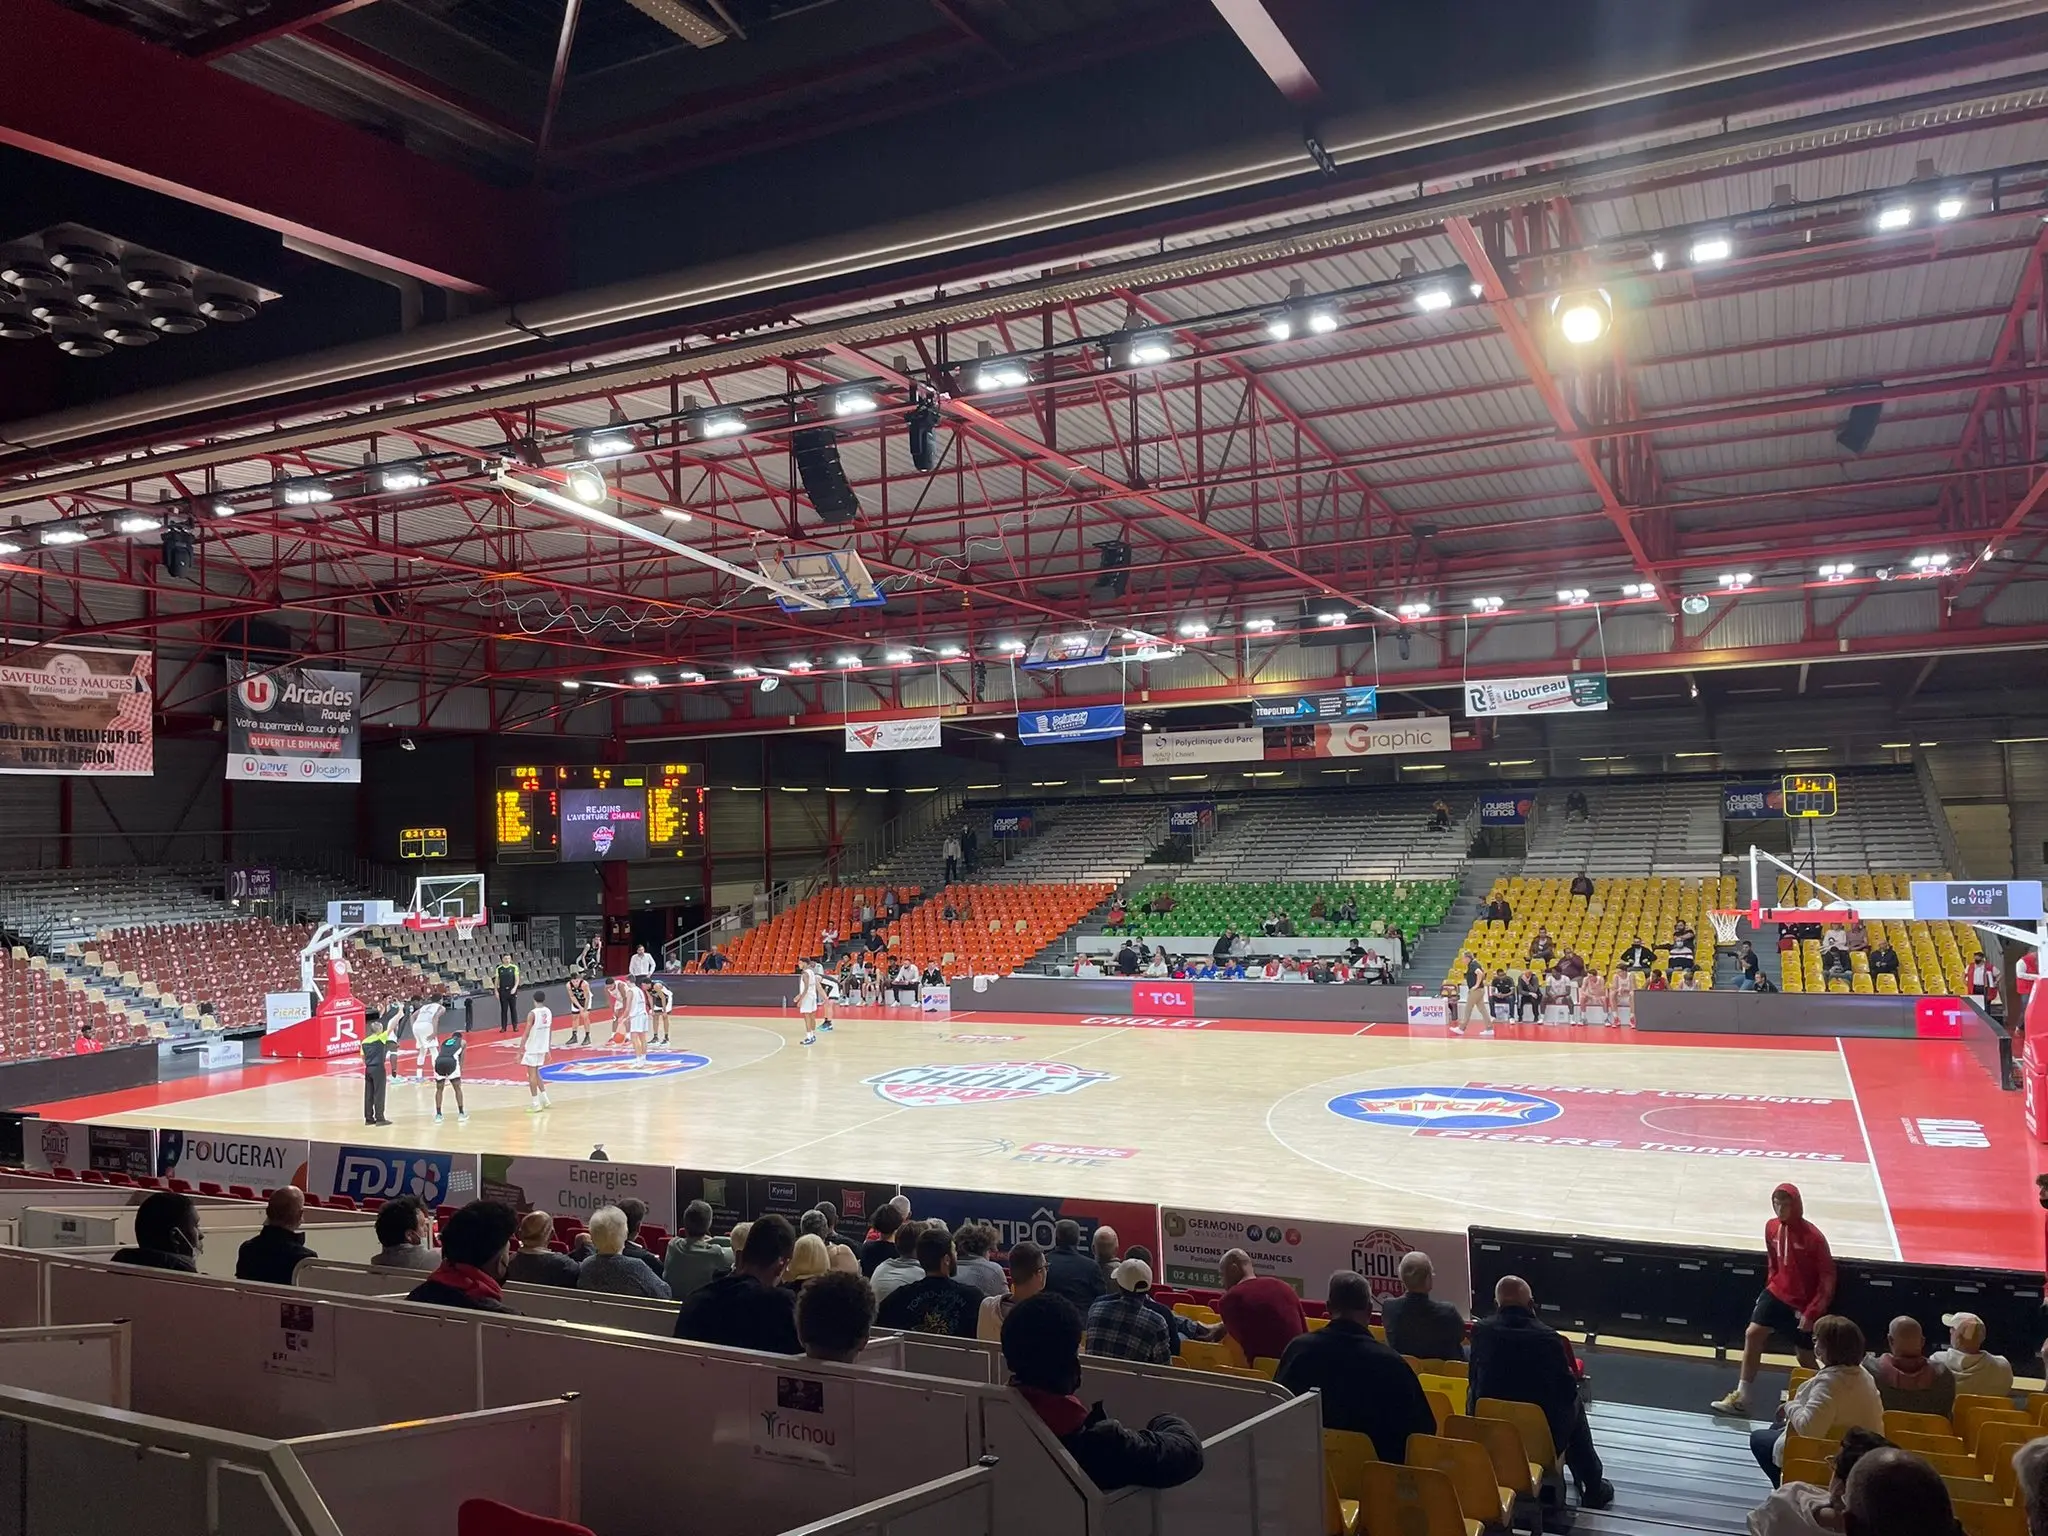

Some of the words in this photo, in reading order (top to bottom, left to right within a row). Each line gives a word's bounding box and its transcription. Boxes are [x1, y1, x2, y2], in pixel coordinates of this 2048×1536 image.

[1, 669, 57, 686] SAVEURS
[59, 676, 78, 686] DES
[80, 677, 133, 691] MAUGES
[281, 683, 353, 706] Arcades
[1503, 680, 1567, 702] Liboureau
[321, 708, 352, 723] Rougé
[236, 717, 258, 729] Votre
[259, 719, 305, 733] supermarché
[48, 726, 61, 742] LE
[64, 728, 124, 744] MEILLEUR
[127, 730, 143, 745] DE
[1175, 736, 1222, 748] Polyclinique
[1224, 735, 1235, 745] du
[1236, 734, 1254, 744] Parc
[1344, 723, 1433, 753] Graphic
[251, 736, 286, 747] OUVERT
[287, 738, 297, 748] LE
[298, 739, 341, 750] DIMANCHE
[21, 746, 66, 763] VOTRE
[260, 763, 288, 772] DRIVE
[316, 766, 350, 775] location
[1729, 792, 1764, 803] ouest
[586, 805, 621, 813] REJOINS
[1485, 800, 1516, 810] ouest
[1726, 800, 1764, 812] france
[566, 813, 609, 822] L'AVENTURE
[611, 812, 641, 821] CHARAL
[1173, 810, 1198, 820] ouest
[1482, 807, 1516, 818] france
[996, 816, 1018, 825] ouest
[1170, 817, 1199, 827] france
[1968, 887, 2003, 898] Angle
[1951, 896, 1966, 905] de
[1968, 896, 1993, 905] Vue
[1151, 992, 1186, 1006] TCL
[1080, 1016, 1220, 1028] CHOLET
[867, 1067, 1112, 1092] CHOLET
[1358, 1098, 1538, 1115] PITCH
[41, 1134, 70, 1154] CHOLET
[1640, 1140, 1845, 1162] Transports
[185, 1139, 287, 1169] FOUGERAY
[340, 1156, 407, 1197] FDJ
[569, 1164, 638, 1189] Energies
[771, 1185, 795, 1198] Kyriad
[845, 1198, 861, 1209] ibis
[1188, 1217, 1244, 1233] GERMOND
[1173, 1243, 1222, 1256] SOLUTIONS
[1173, 1269, 1185, 1280] 02
[1188, 1272, 1199, 1282] 41
